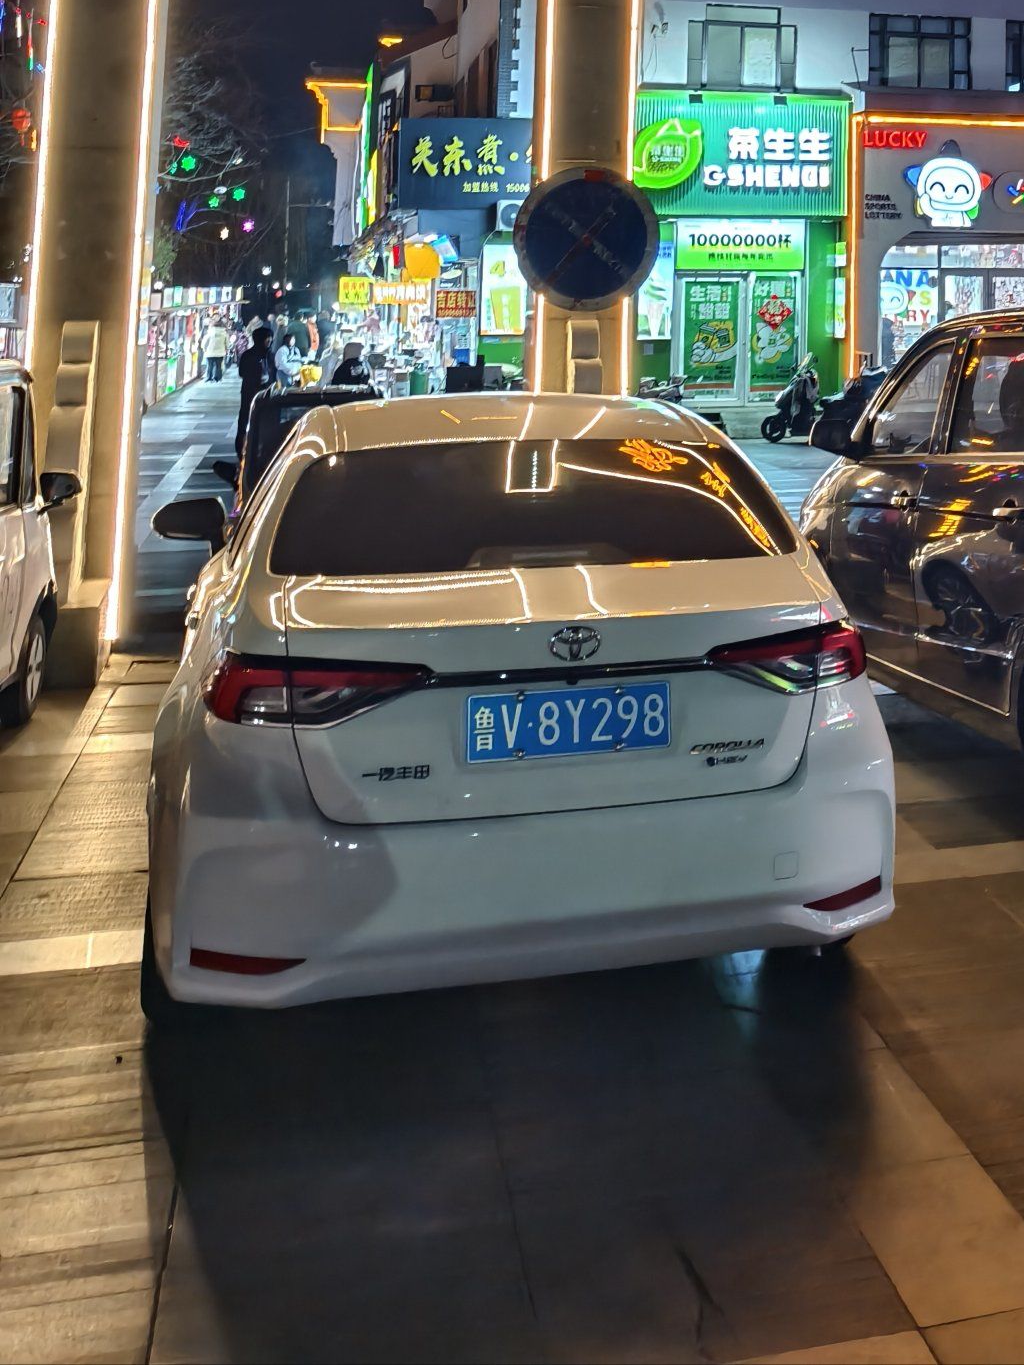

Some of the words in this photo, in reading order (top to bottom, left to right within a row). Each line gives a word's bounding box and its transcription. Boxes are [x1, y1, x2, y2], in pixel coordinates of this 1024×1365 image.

[728, 127, 832, 162] 茶生生
[863, 130, 928, 148] LUCKY
[411, 134, 533, 178] 关东煮·
[462, 181, 498, 193] 加盟热线
[865, 202, 897, 211] SPORTS
[865, 211, 902, 220] LOTTERY
[688, 233, 792, 249] 10000000杯
[689, 738, 765, 755] COROLLA
[362, 764, 431, 782] 一汽丰田
